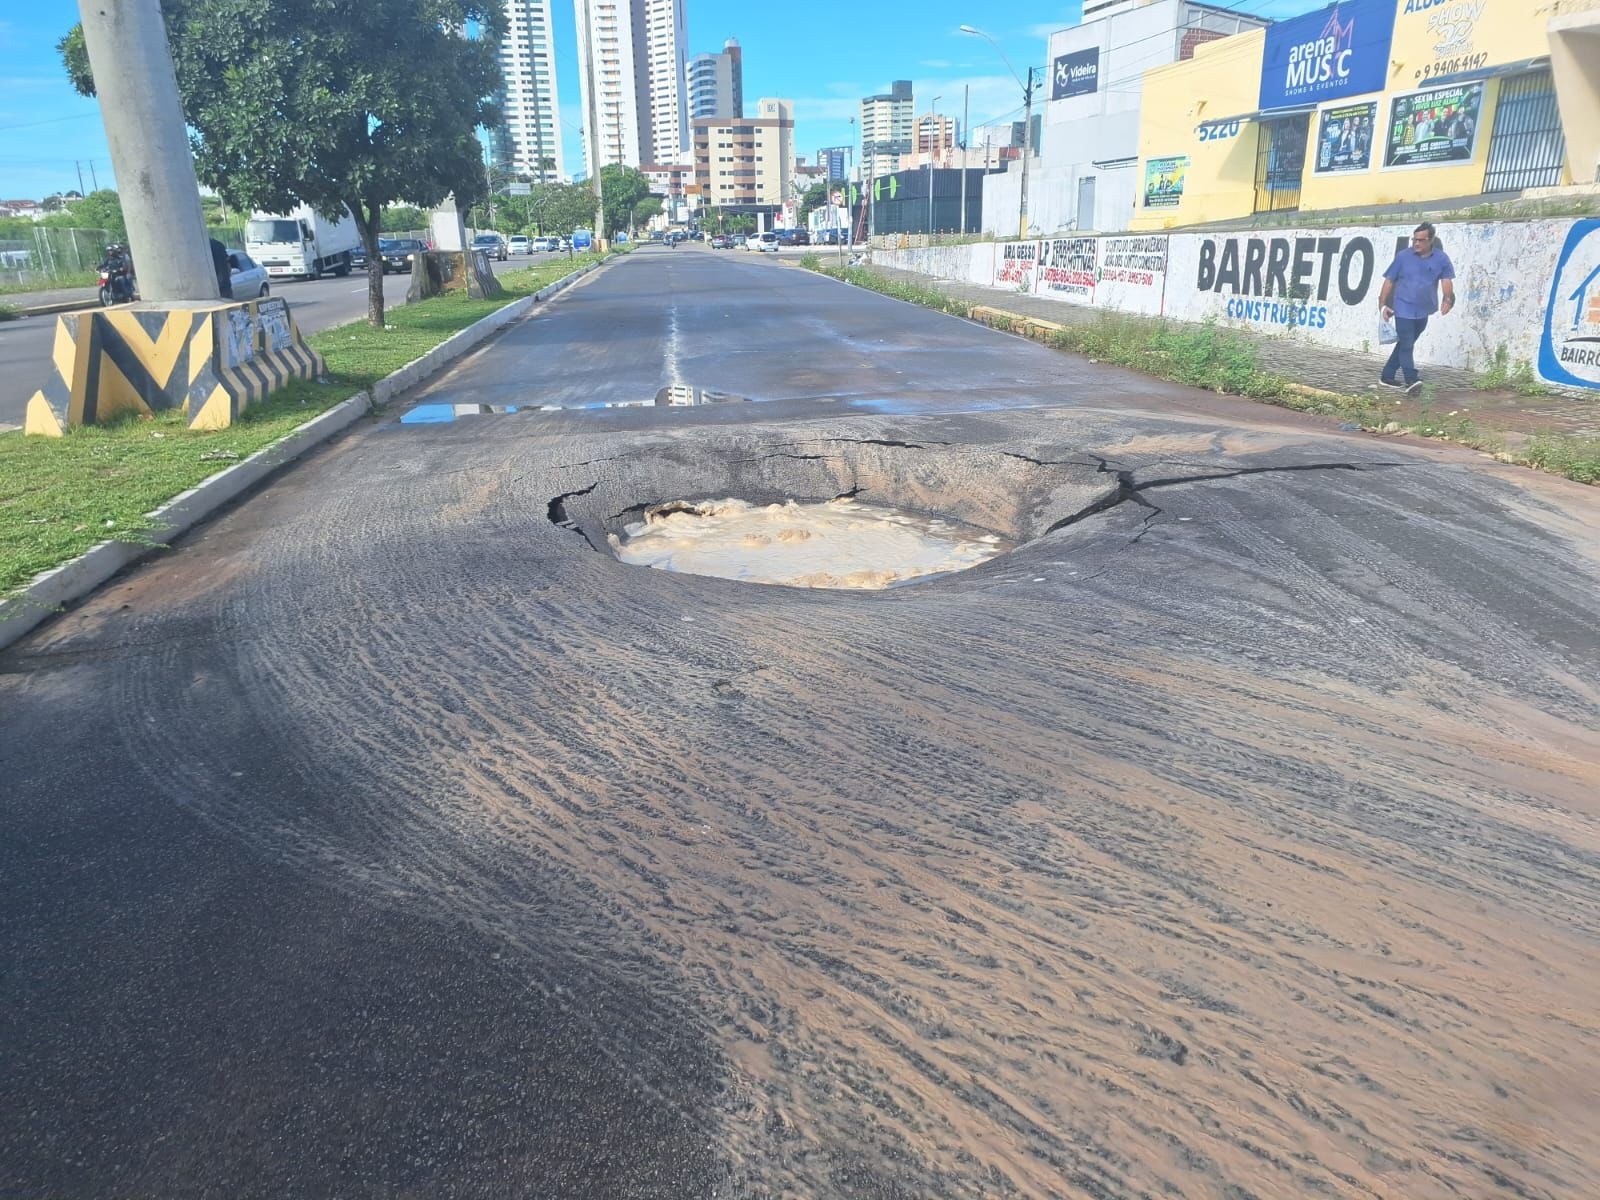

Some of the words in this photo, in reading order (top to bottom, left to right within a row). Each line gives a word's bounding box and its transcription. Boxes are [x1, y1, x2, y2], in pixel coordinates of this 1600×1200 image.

[1289, 36, 1335, 63] arena
[1070, 63, 1097, 79] Videira
[1316, 78, 1349, 91] EVENTOS
[1414, 90, 1433, 104] SEXTA
[1434, 87, 1464, 101] ESPECIAL
[1016, 243, 1035, 260] GESSO
[1053, 238, 1096, 255] FERRAMENTAS
[1050, 254, 1095, 272] AUTOMOTIVAS
[1197, 236, 1375, 306] BARRETO
